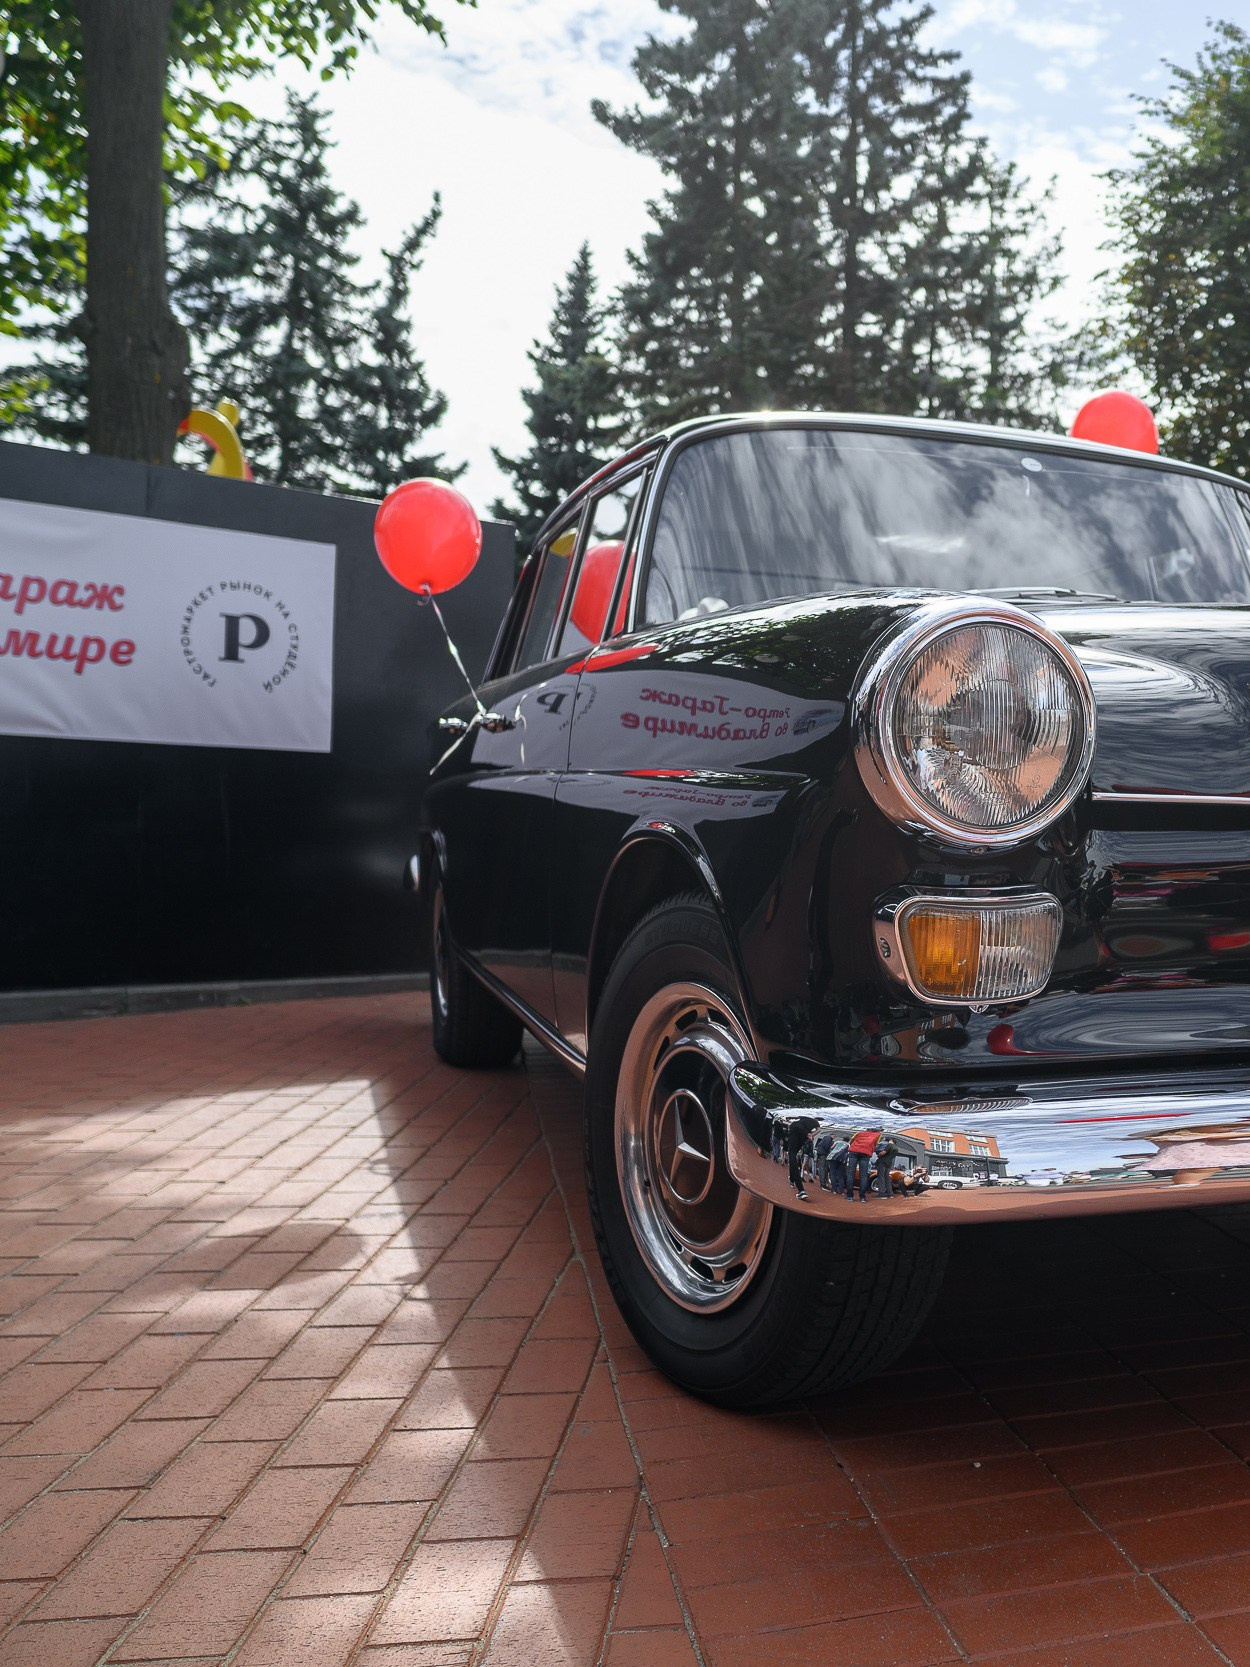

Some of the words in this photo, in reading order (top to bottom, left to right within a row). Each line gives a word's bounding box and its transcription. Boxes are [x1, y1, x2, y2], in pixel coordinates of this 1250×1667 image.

[219, 580, 274, 601] РЫНОК
[275, 600, 291, 620] НА
[218, 611, 271, 664] Р
